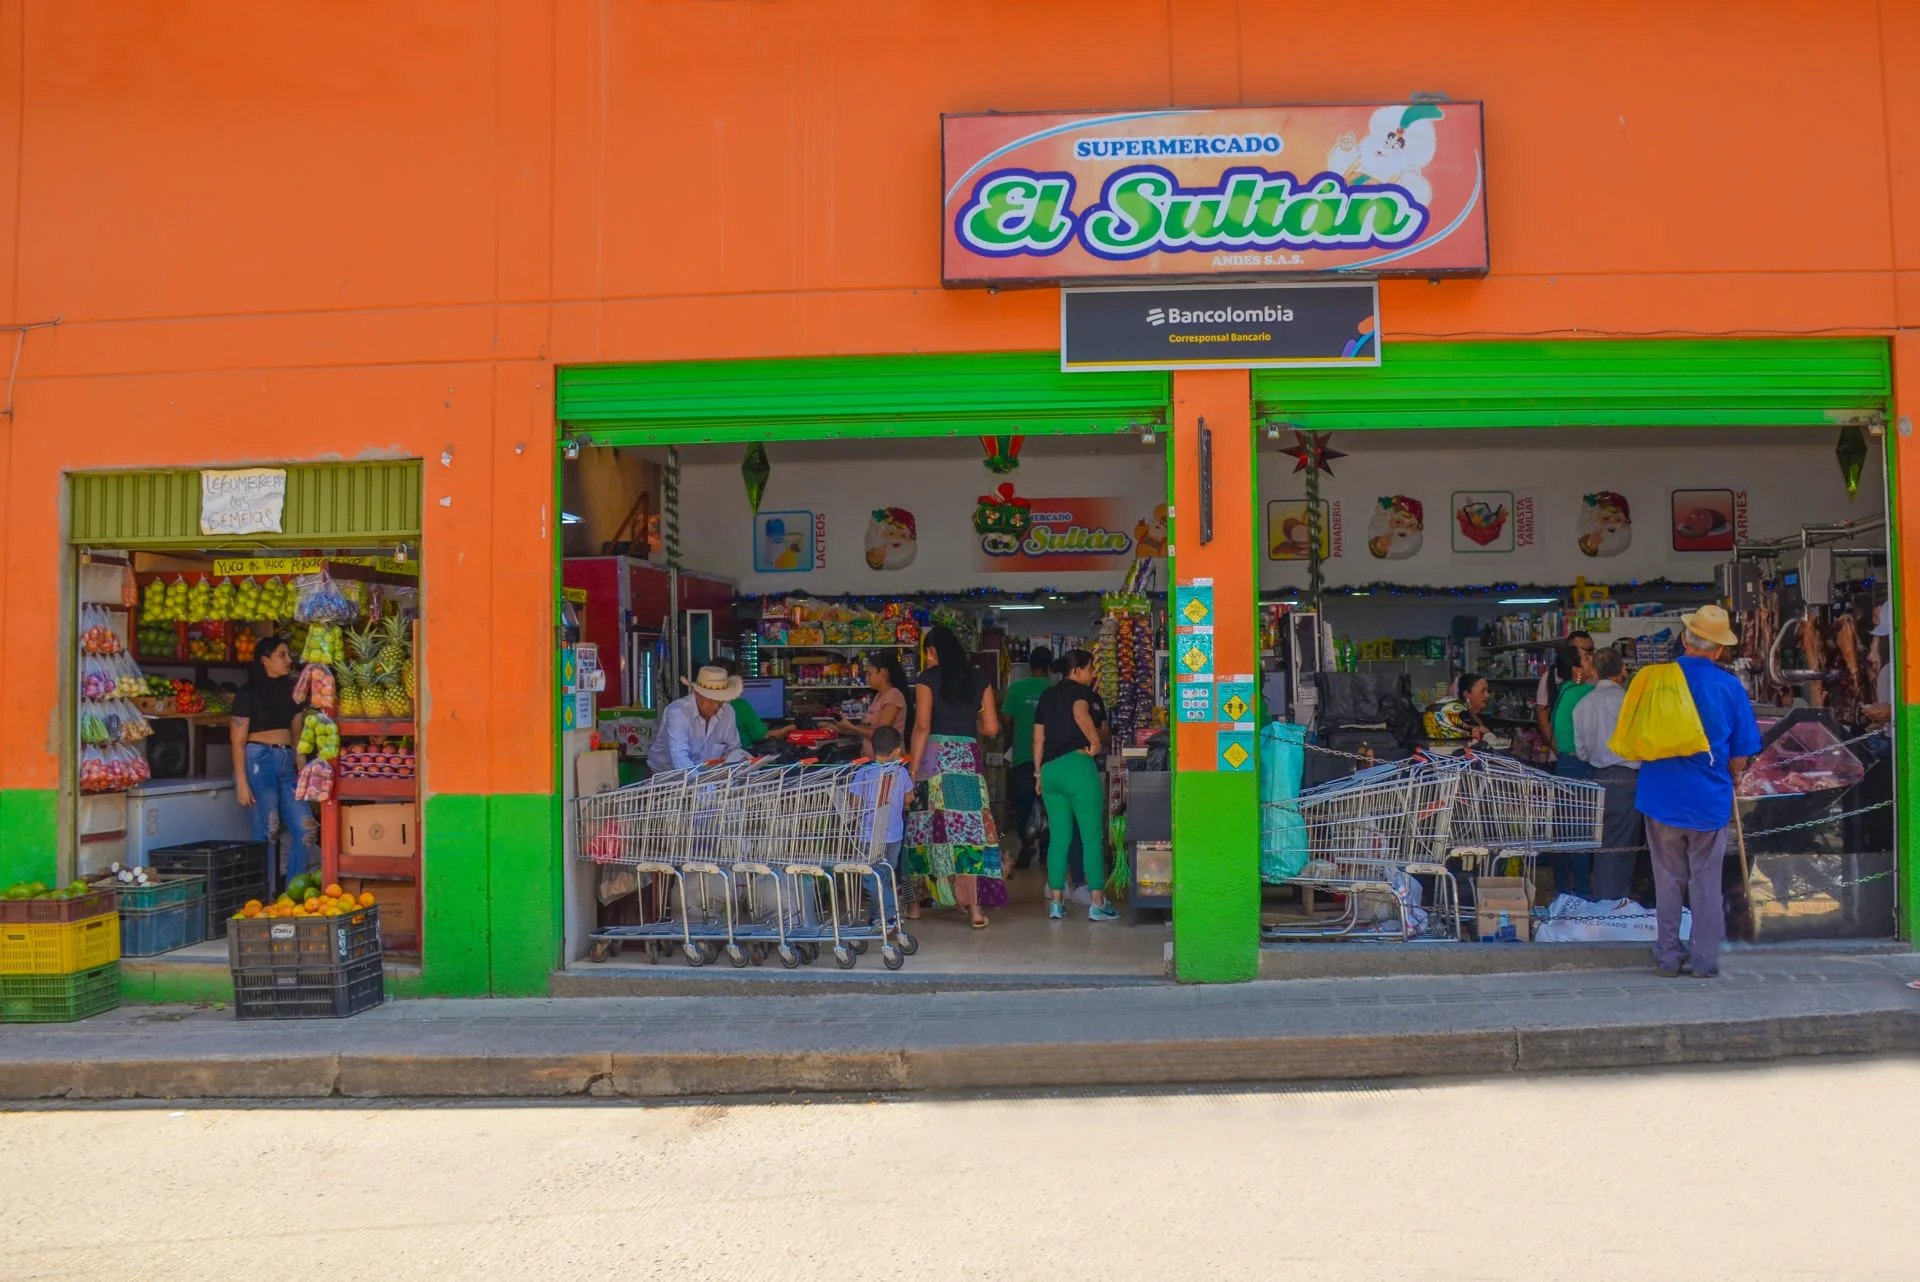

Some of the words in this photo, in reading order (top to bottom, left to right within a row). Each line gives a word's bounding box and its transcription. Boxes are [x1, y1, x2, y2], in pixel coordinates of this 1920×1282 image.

[1076, 135, 1281, 158] SUPERMERCADO
[961, 172, 1073, 250] El
[1084, 171, 1419, 253] Sultán
[1211, 255, 1261, 267] ANDES
[1264, 253, 1305, 266] S.A.S.
[1168, 305, 1295, 325] Bancolombia
[1168, 332, 1230, 345] Corresponsal
[1231, 331, 1272, 343] Bancario
[1516, 498, 1525, 548] CANASTA
[1525, 496, 1534, 545] FAMILIAR
[1735, 490, 1748, 543] ARNES
[815, 512, 826, 569] LACTEOS
[1024, 527, 1129, 553] Sultán
